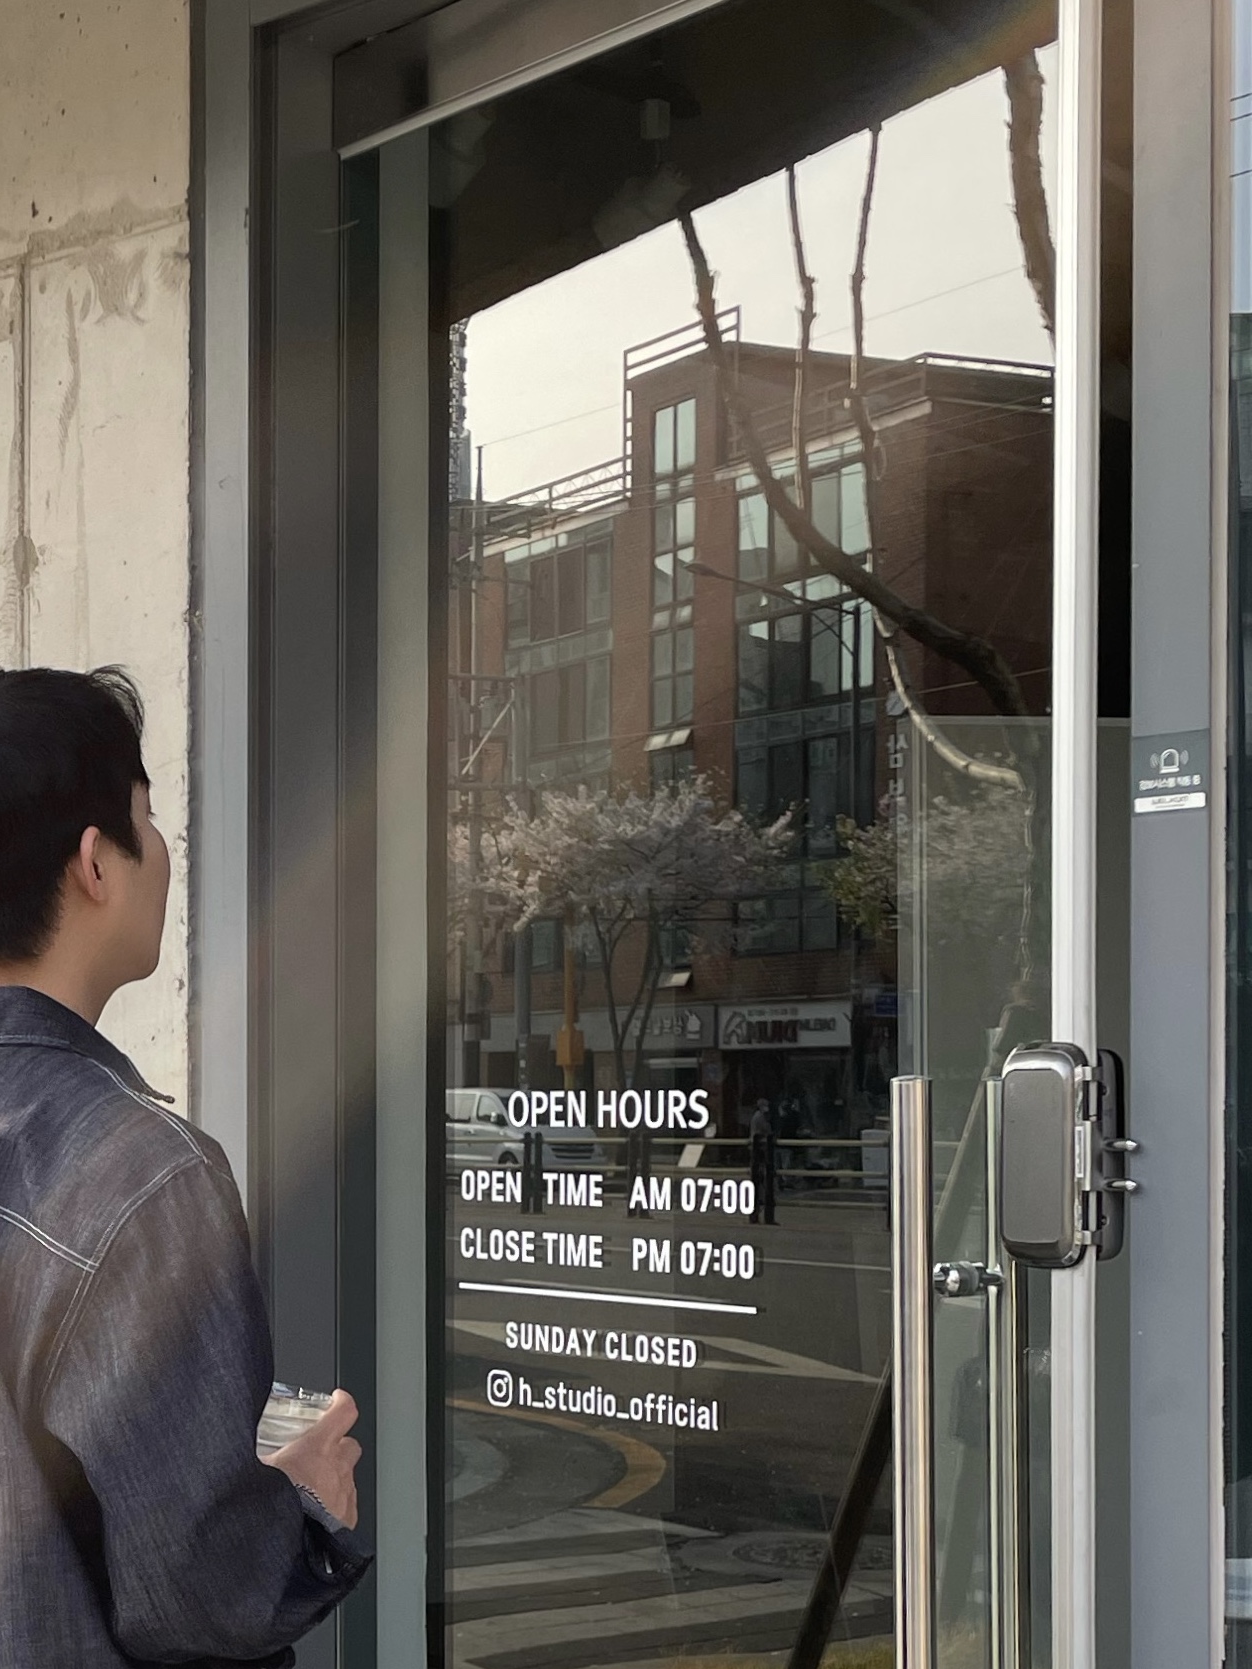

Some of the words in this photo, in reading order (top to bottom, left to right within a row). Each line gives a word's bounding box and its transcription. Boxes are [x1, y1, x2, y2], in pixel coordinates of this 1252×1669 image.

[507, 1089, 587, 1128] OPEN
[597, 1088, 710, 1130] HOURS
[461, 1169, 522, 1203] OPEN
[542, 1172, 604, 1208] TIME
[629, 1175, 672, 1211] AM
[680, 1177, 755, 1215] 07:00
[460, 1227, 536, 1264] CLOSE
[542, 1232, 603, 1269] TIME
[632, 1236, 671, 1274] PM
[680, 1240, 755, 1280] 07:00
[505, 1321, 597, 1358] SUNDAY
[604, 1330, 697, 1369] CLOSED
[518, 1376, 720, 1432] h_studio_official
